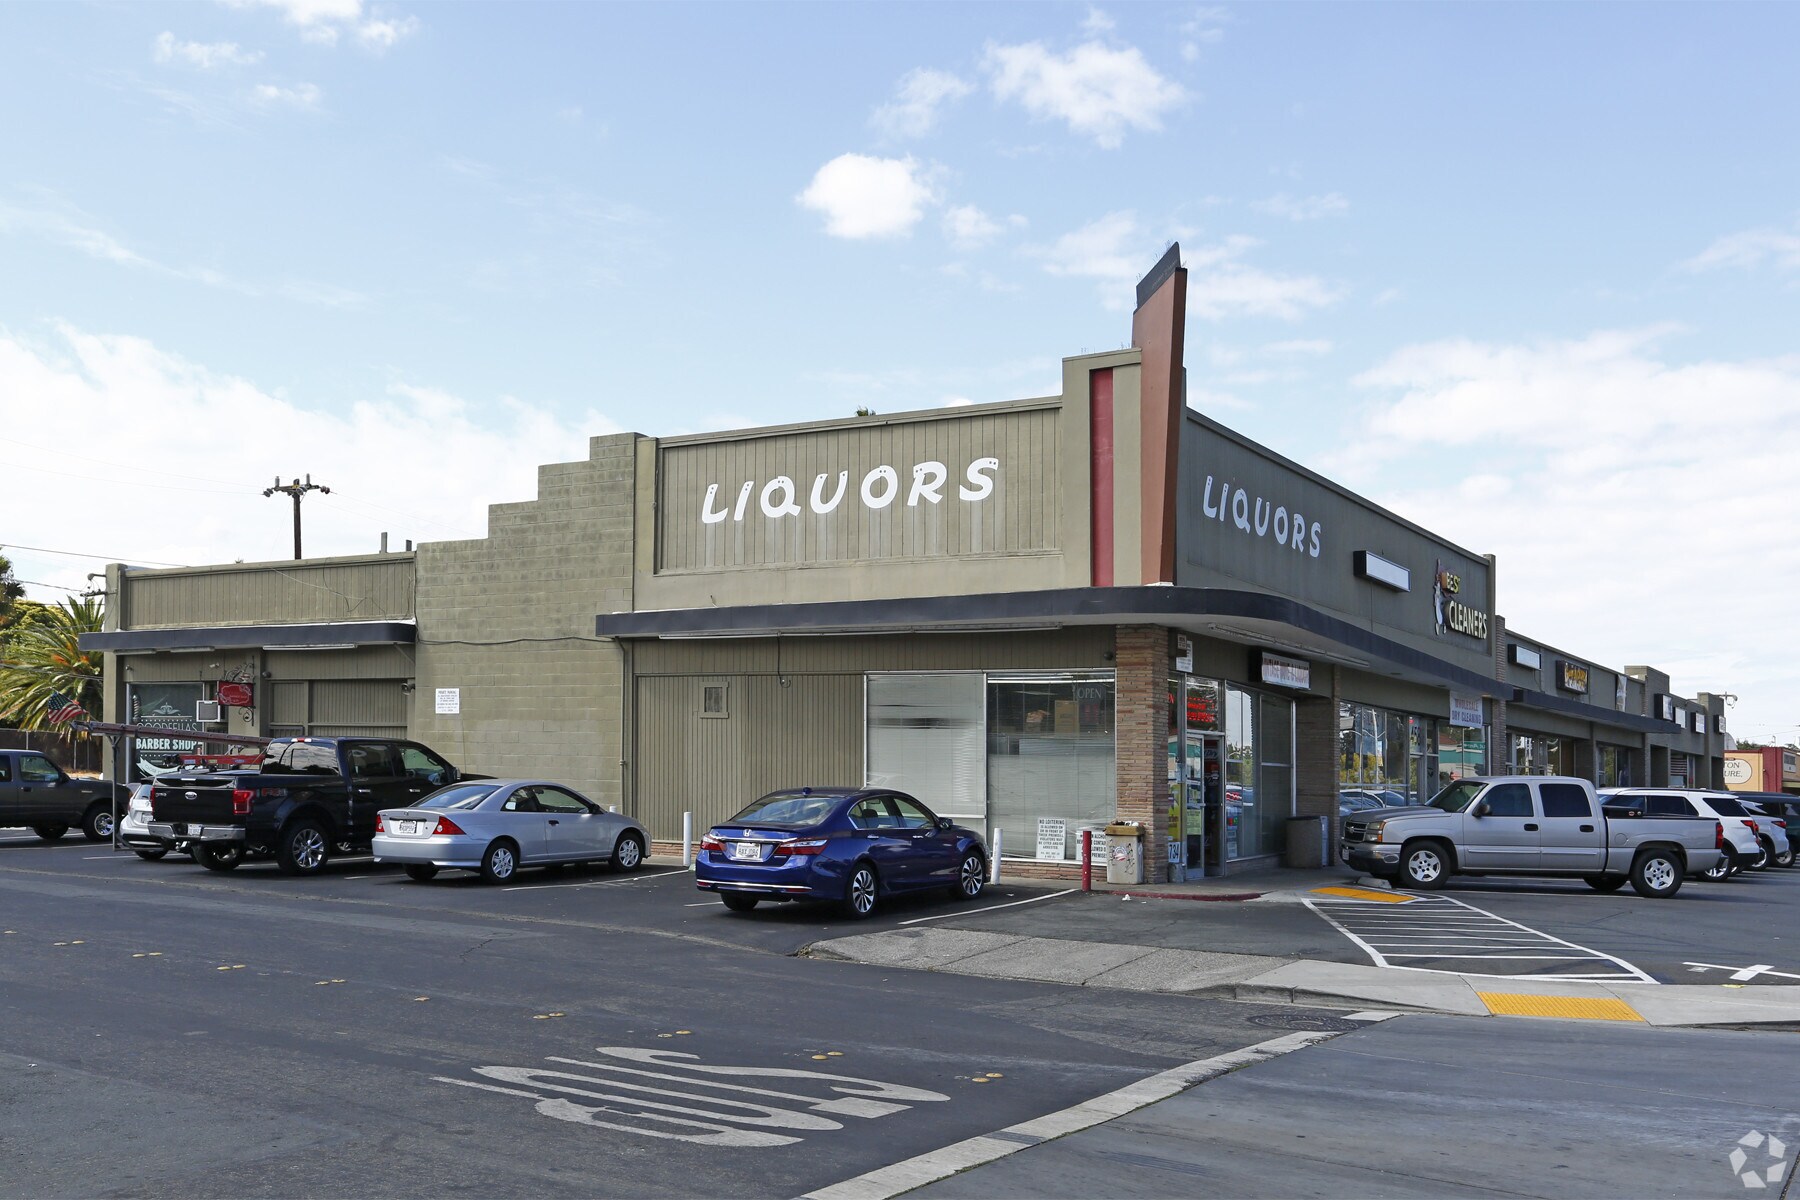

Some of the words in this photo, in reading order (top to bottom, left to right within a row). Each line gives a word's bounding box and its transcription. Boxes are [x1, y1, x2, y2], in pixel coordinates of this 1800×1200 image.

[701, 457, 999, 524] LIQUORS
[1202, 475, 1322, 558] LIQUORS
[1448, 600, 1487, 640] CLEANERS
[1077, 687, 1102, 699] OPEN
[1451, 710, 1461, 721] DRY
[1461, 711, 1482, 725] CLEANING
[135, 738, 171, 750] BARBER
[172, 739, 197, 751] SHOP
[1724, 761, 1740, 769] ON
[1169, 844, 1179, 859] 734
[428, 1046, 951, 1147] STOP
